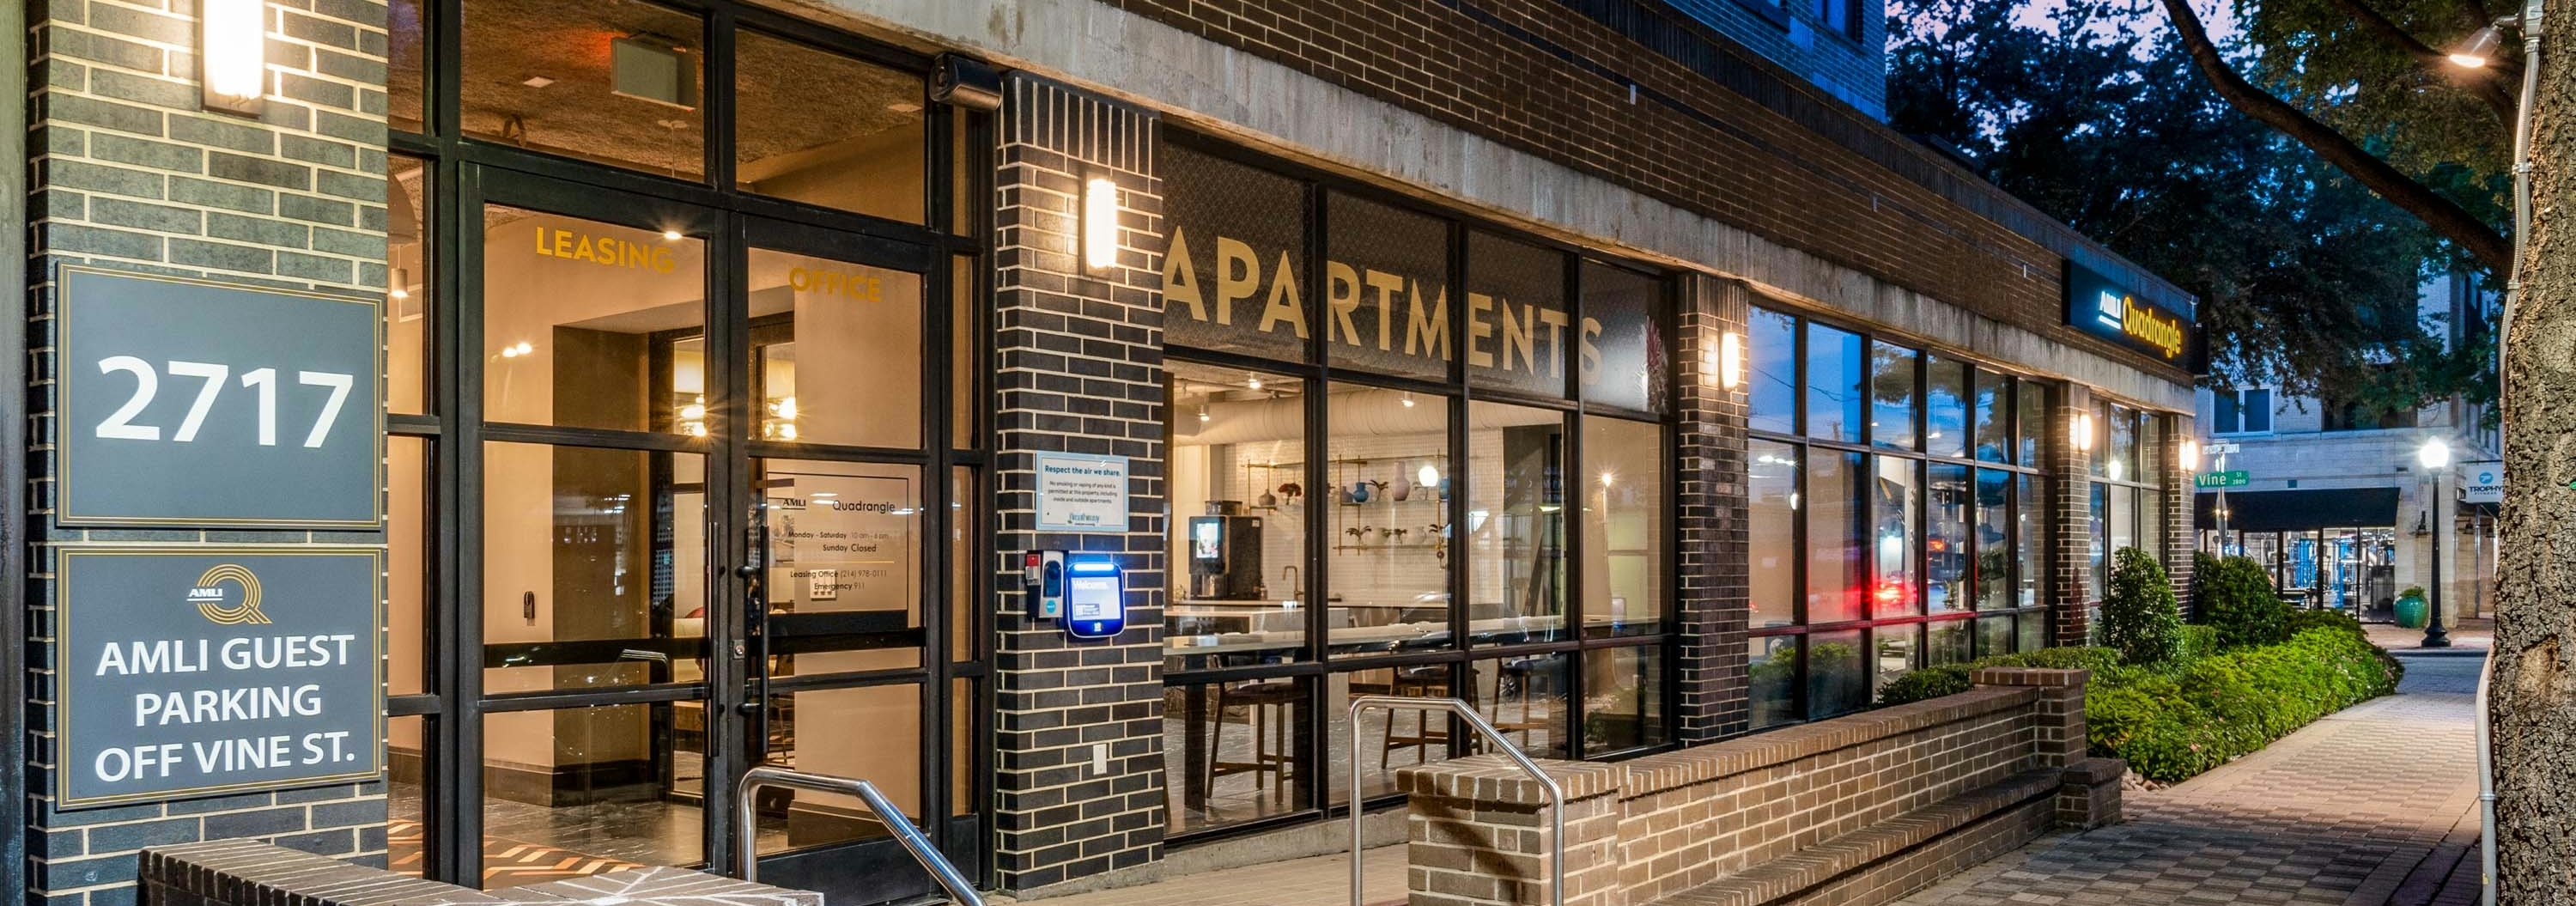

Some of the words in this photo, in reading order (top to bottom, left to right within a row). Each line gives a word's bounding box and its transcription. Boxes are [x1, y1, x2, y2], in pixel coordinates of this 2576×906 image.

[536, 226, 674, 274] LEASING
[789, 267, 882, 302] OFFICE
[1163, 225, 1602, 386] APARTMENTS
[2123, 296, 2182, 358] Quadrangle
[95, 355, 354, 448] 2717
[1045, 465, 1071, 475] Respect
[2198, 474, 2227, 486] Vine
[782, 498, 806, 507] AMLI
[832, 500, 896, 514] Quadrangle
[788, 531, 814, 539] Monday
[820, 531, 847, 540] Saturday
[823, 544, 848, 553] Sunday
[851, 544, 877, 552] Closed
[790, 570, 817, 579] Leasing
[188, 587, 223, 598] AMLI
[814, 582, 853, 591] Emergency
[95, 639, 209, 676] AMLI
[221, 634, 355, 670] GUEST
[135, 684, 322, 727] PARKING
[94, 743, 183, 782] OFF
[192, 735, 291, 774] VINE
[302, 731, 355, 765] ST.
